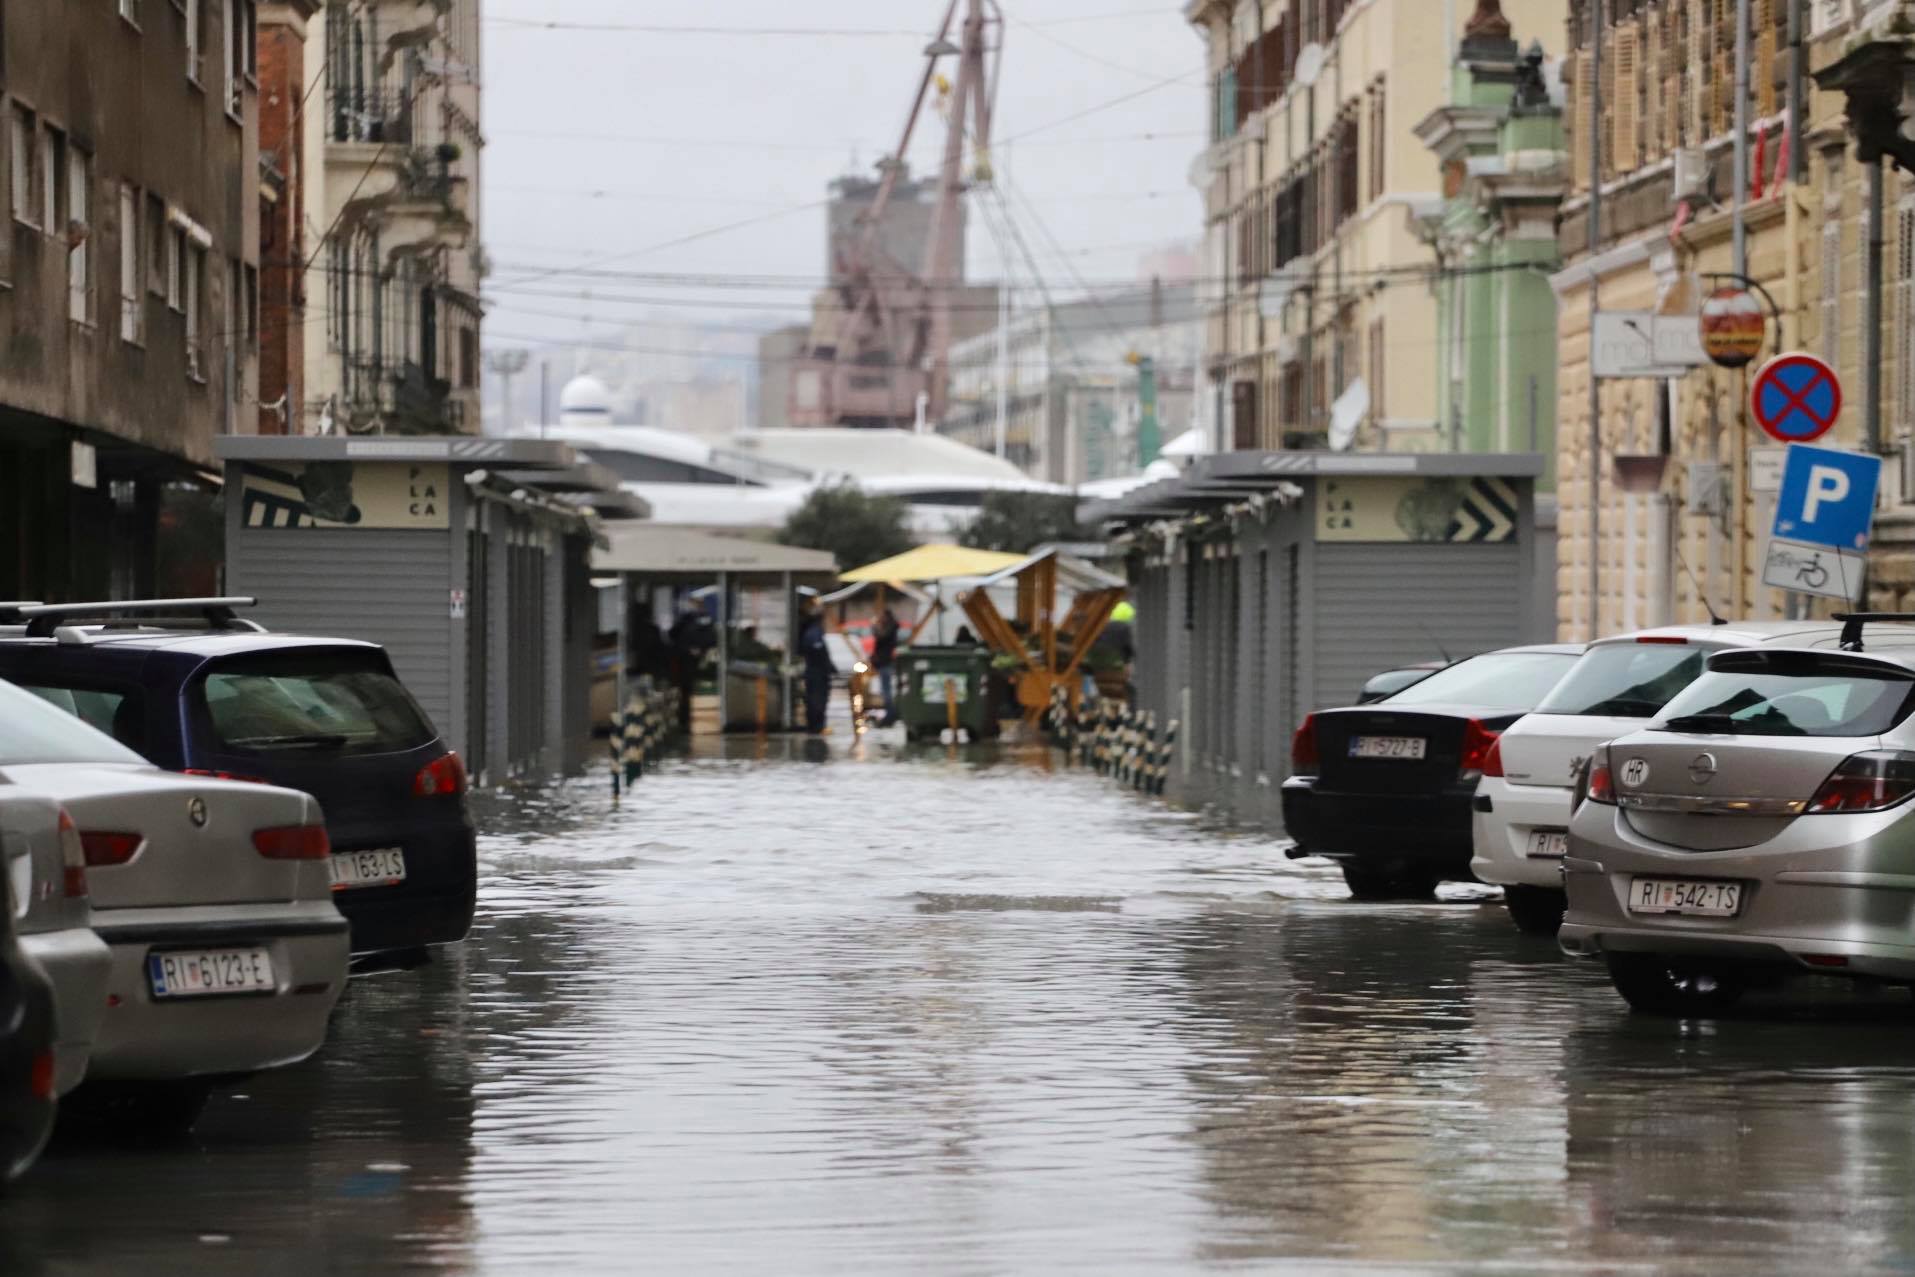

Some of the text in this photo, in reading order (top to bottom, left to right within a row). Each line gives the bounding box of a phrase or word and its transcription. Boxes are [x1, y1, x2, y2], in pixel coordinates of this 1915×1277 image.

[1801, 464, 1850, 524] P
[1626, 759, 1644, 783] HR
[1537, 833, 1552, 852] RI
[352, 852, 402, 878] 163-LS
[1642, 882, 1660, 905] RI
[164, 957, 187, 988] RI
